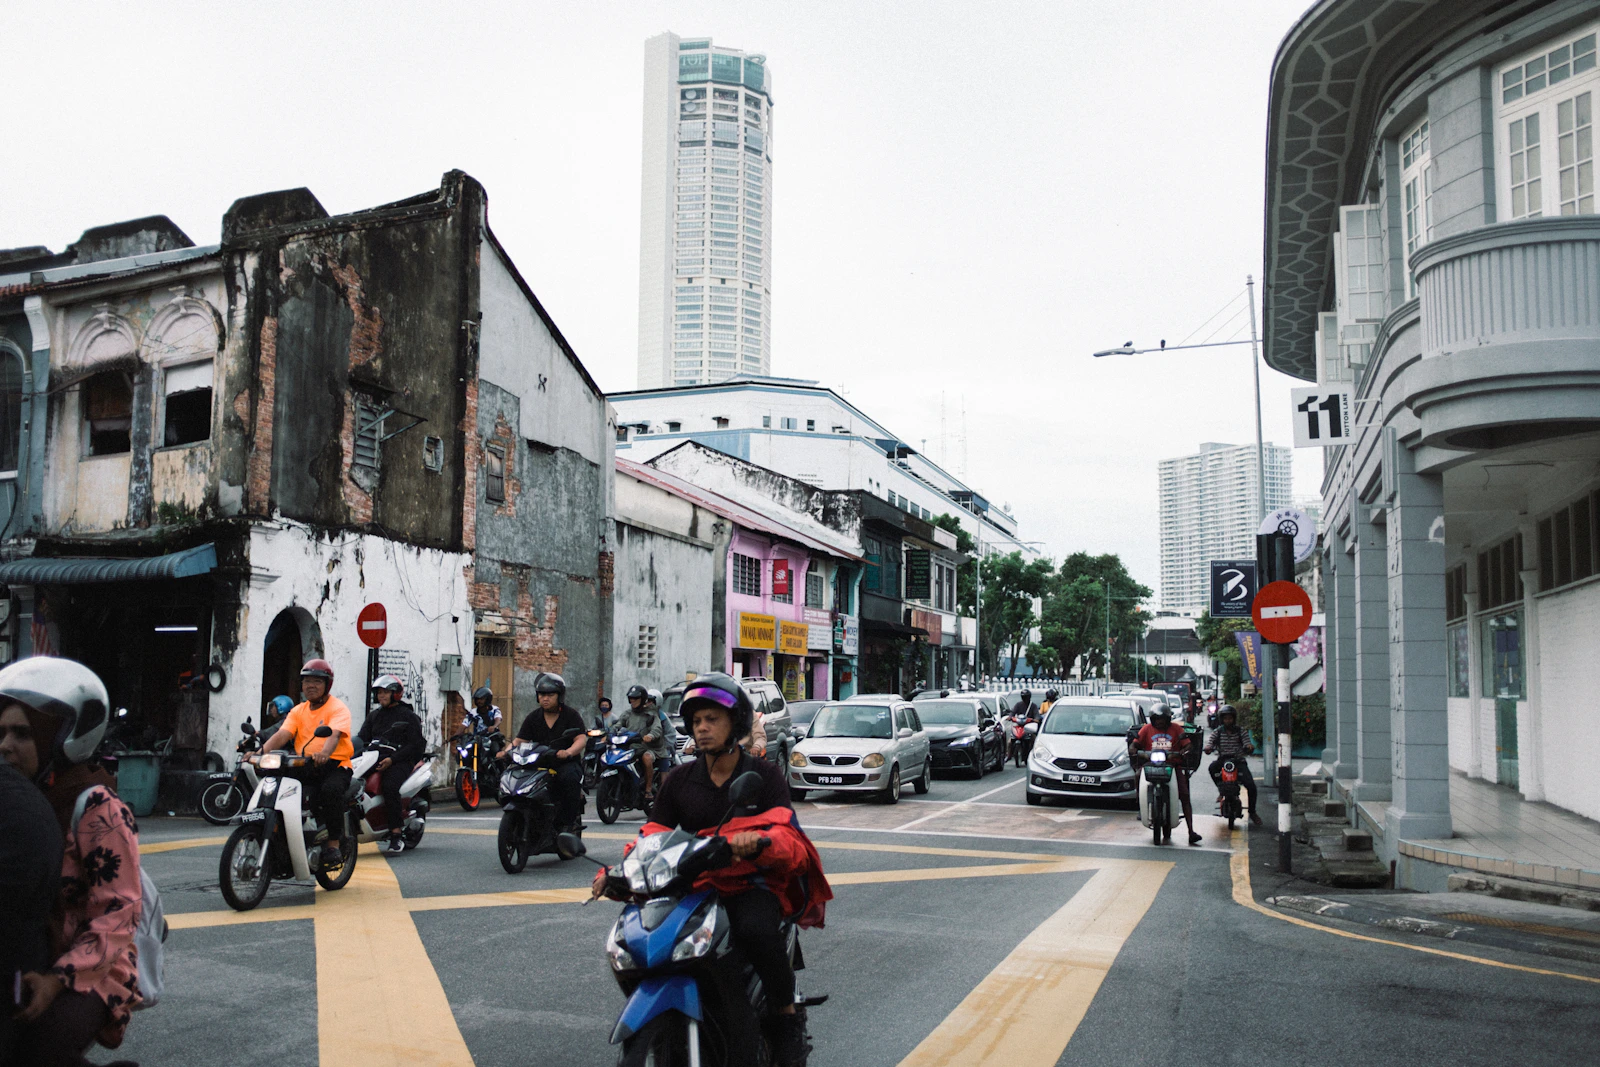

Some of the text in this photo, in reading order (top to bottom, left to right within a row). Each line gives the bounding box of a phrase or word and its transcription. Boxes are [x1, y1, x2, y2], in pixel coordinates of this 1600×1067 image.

[1298, 394, 1342, 439] 11
[818, 776, 843, 784] PFB 2419
[1081, 775, 1095, 784] 4730
